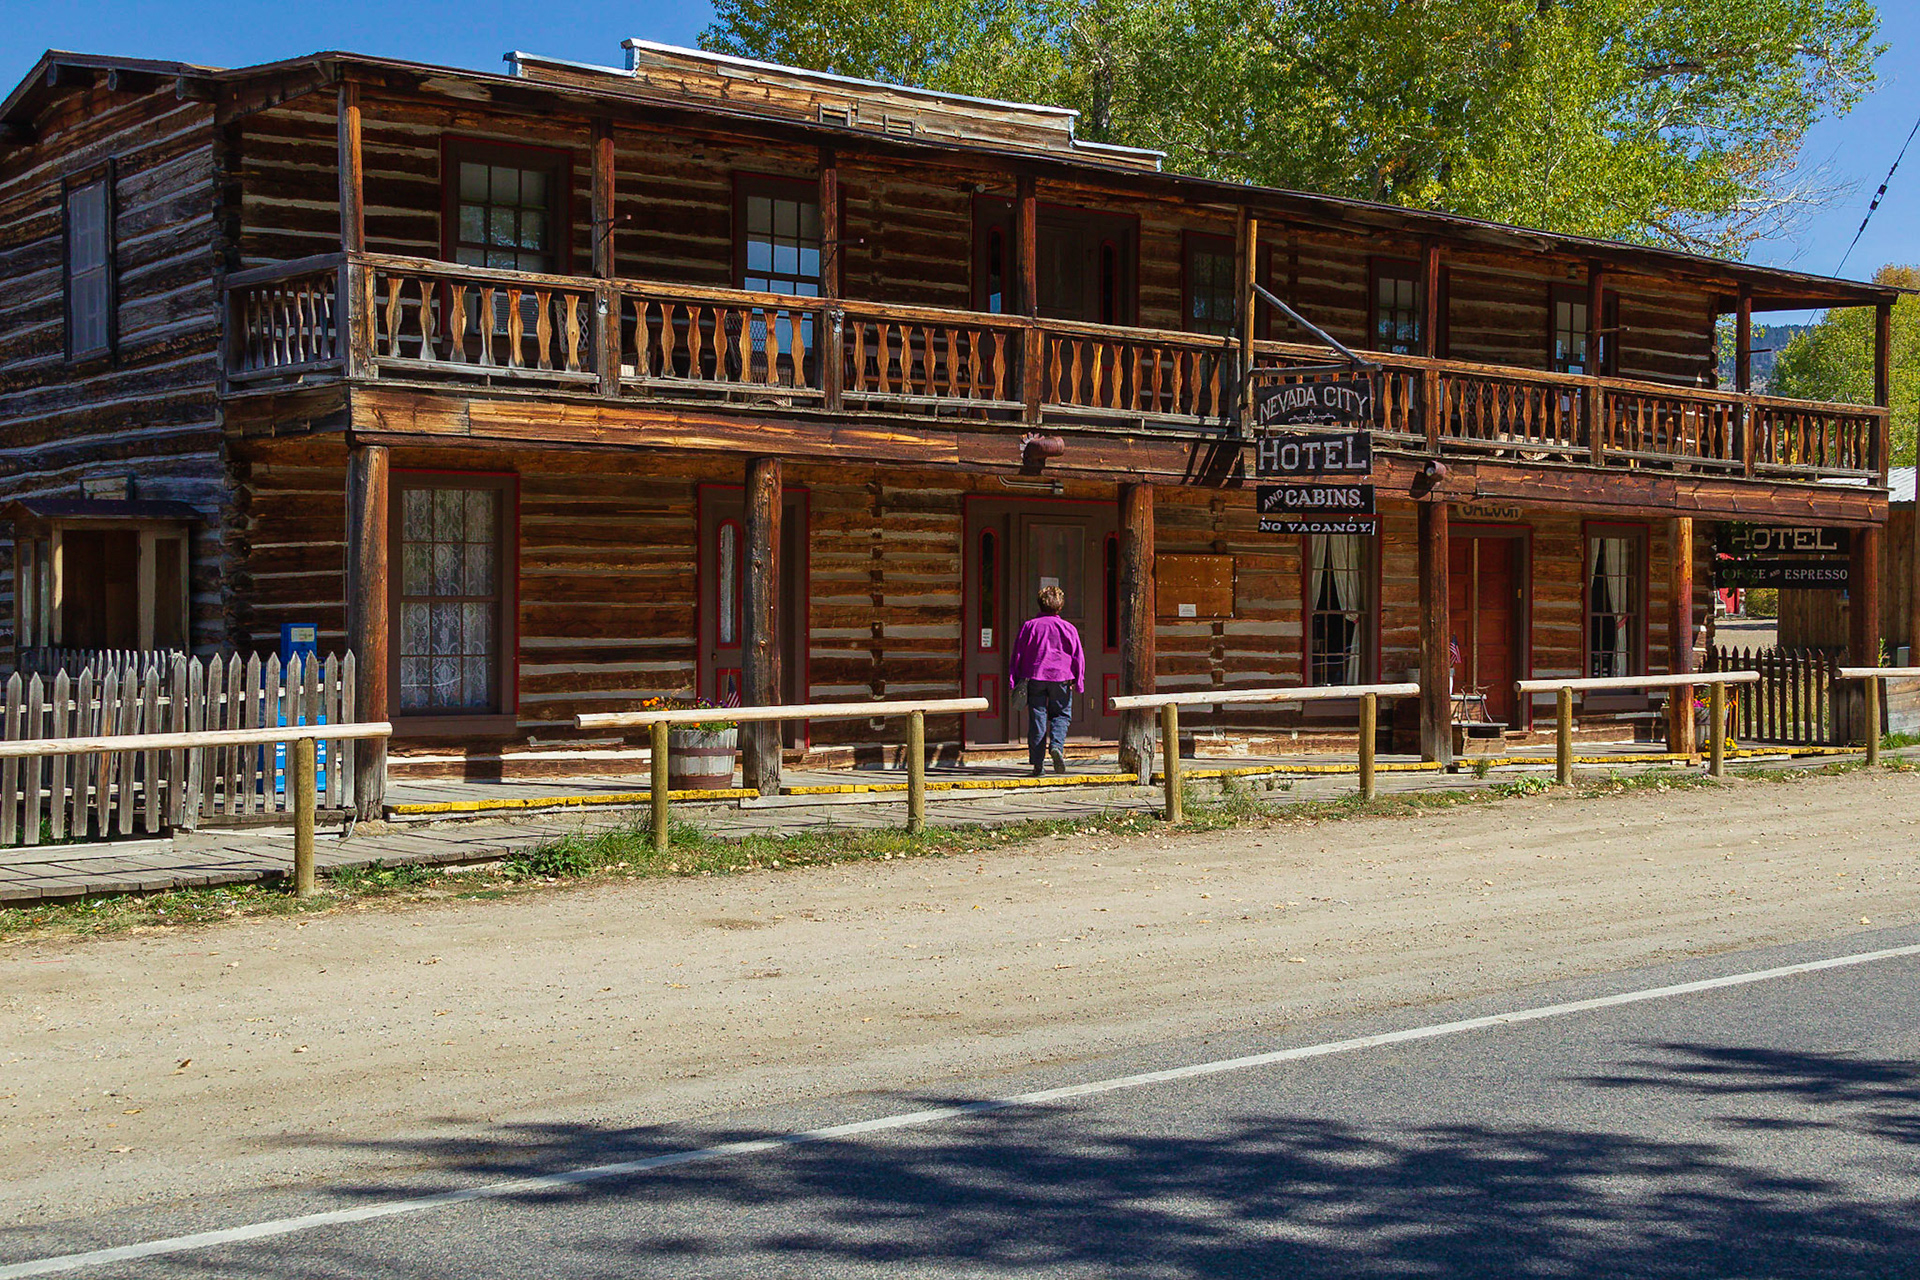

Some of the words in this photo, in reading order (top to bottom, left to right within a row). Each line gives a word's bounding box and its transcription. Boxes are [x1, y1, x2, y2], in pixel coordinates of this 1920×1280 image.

[1260, 386, 1318, 424] NEVADA
[1324, 386, 1368, 417] CITY
[1259, 436, 1367, 470] HOTEL
[1264, 489, 1284, 511] AND
[1260, 521, 1282, 532] NO
[1784, 568, 1849, 580] ESPRESSO
